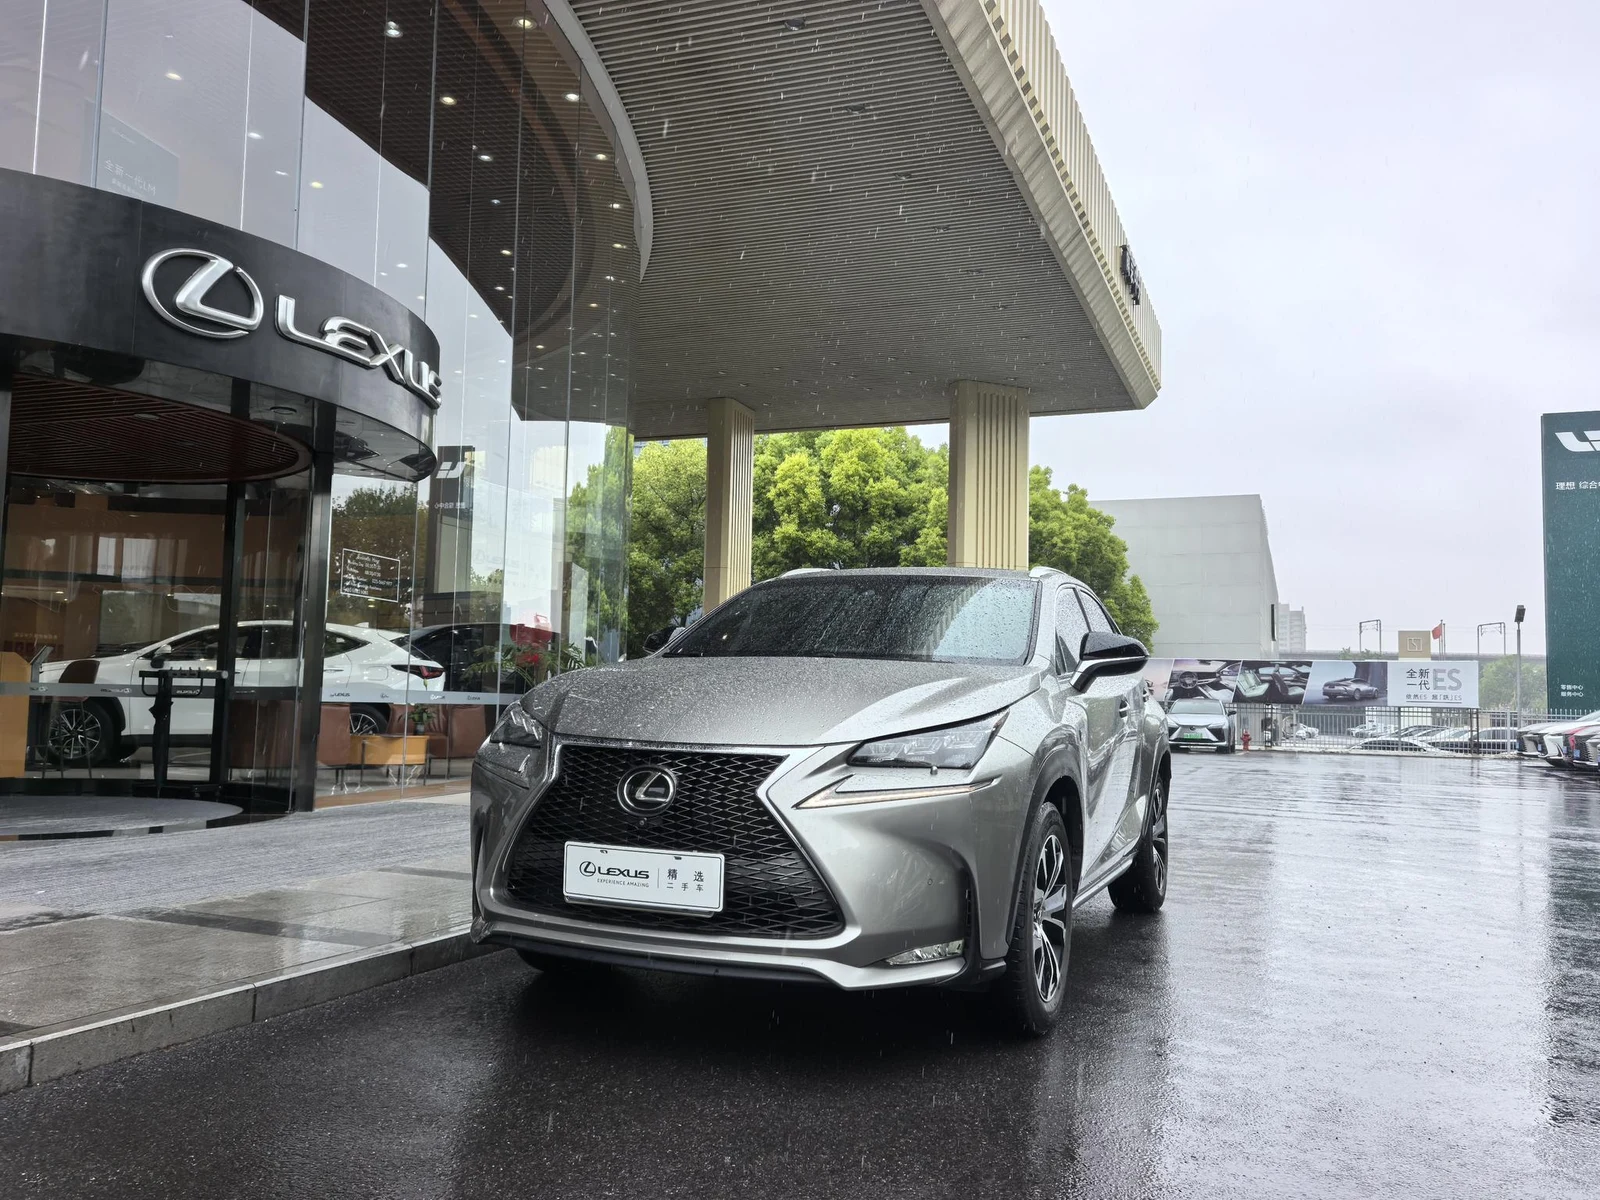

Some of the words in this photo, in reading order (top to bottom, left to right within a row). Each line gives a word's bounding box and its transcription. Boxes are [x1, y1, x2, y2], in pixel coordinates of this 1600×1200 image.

[274, 294, 442, 409] LEXUS
[1555, 481, 1576, 490] 理想
[1578, 480, 1600, 490] 综合
[1406, 668, 1430, 679] 全新
[1406, 680, 1430, 690] 一代
[1433, 668, 1462, 691] ES
[597, 866, 650, 880] LEXUS
[667, 868, 704, 882] 精选
[597, 878, 626, 886] EXPERIENCE
[626, 880, 650, 888] AMAZING
[666, 882, 704, 892] 二手车
